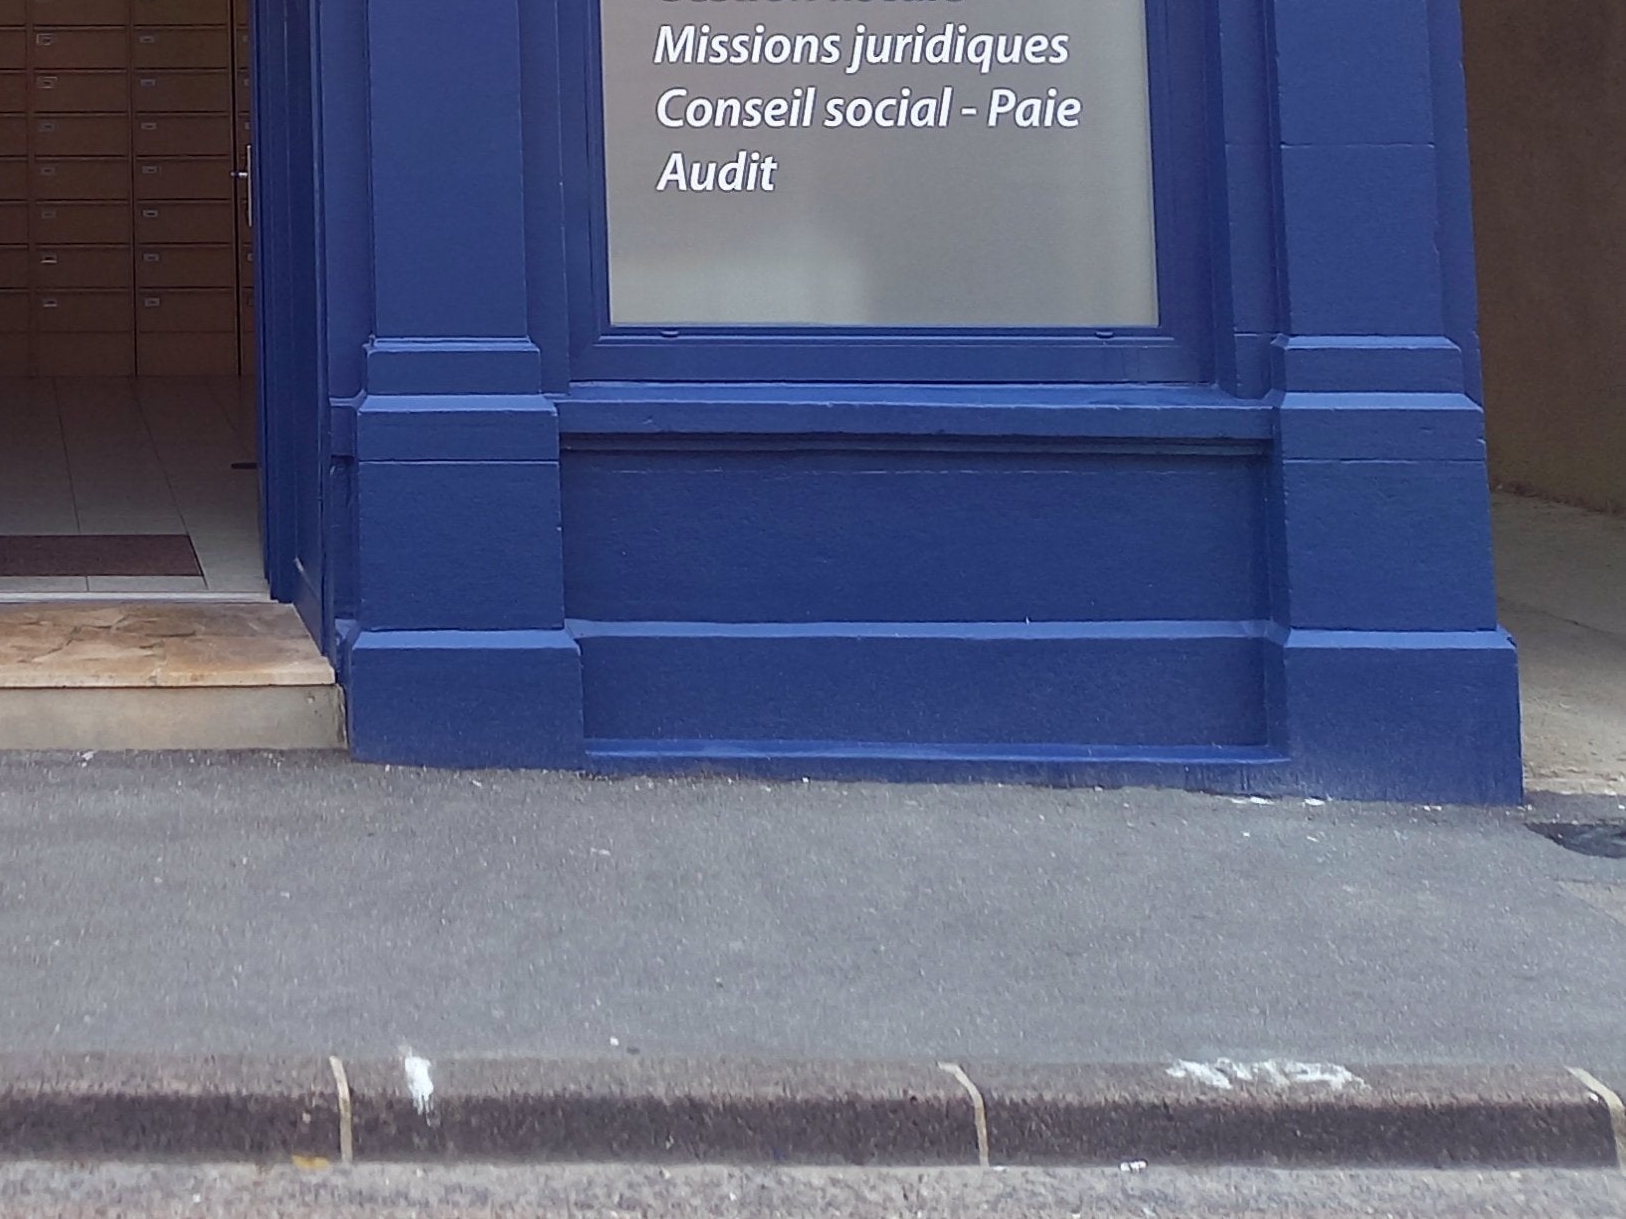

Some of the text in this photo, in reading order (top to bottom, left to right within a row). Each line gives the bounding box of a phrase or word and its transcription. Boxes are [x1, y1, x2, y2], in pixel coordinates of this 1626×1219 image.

[653, 22, 1070, 75] Missions juridiques
[656, 86, 817, 128] Conseil
[823, 86, 953, 128] social
[987, 87, 1082, 128] Paie
[655, 150, 779, 192] Audit
